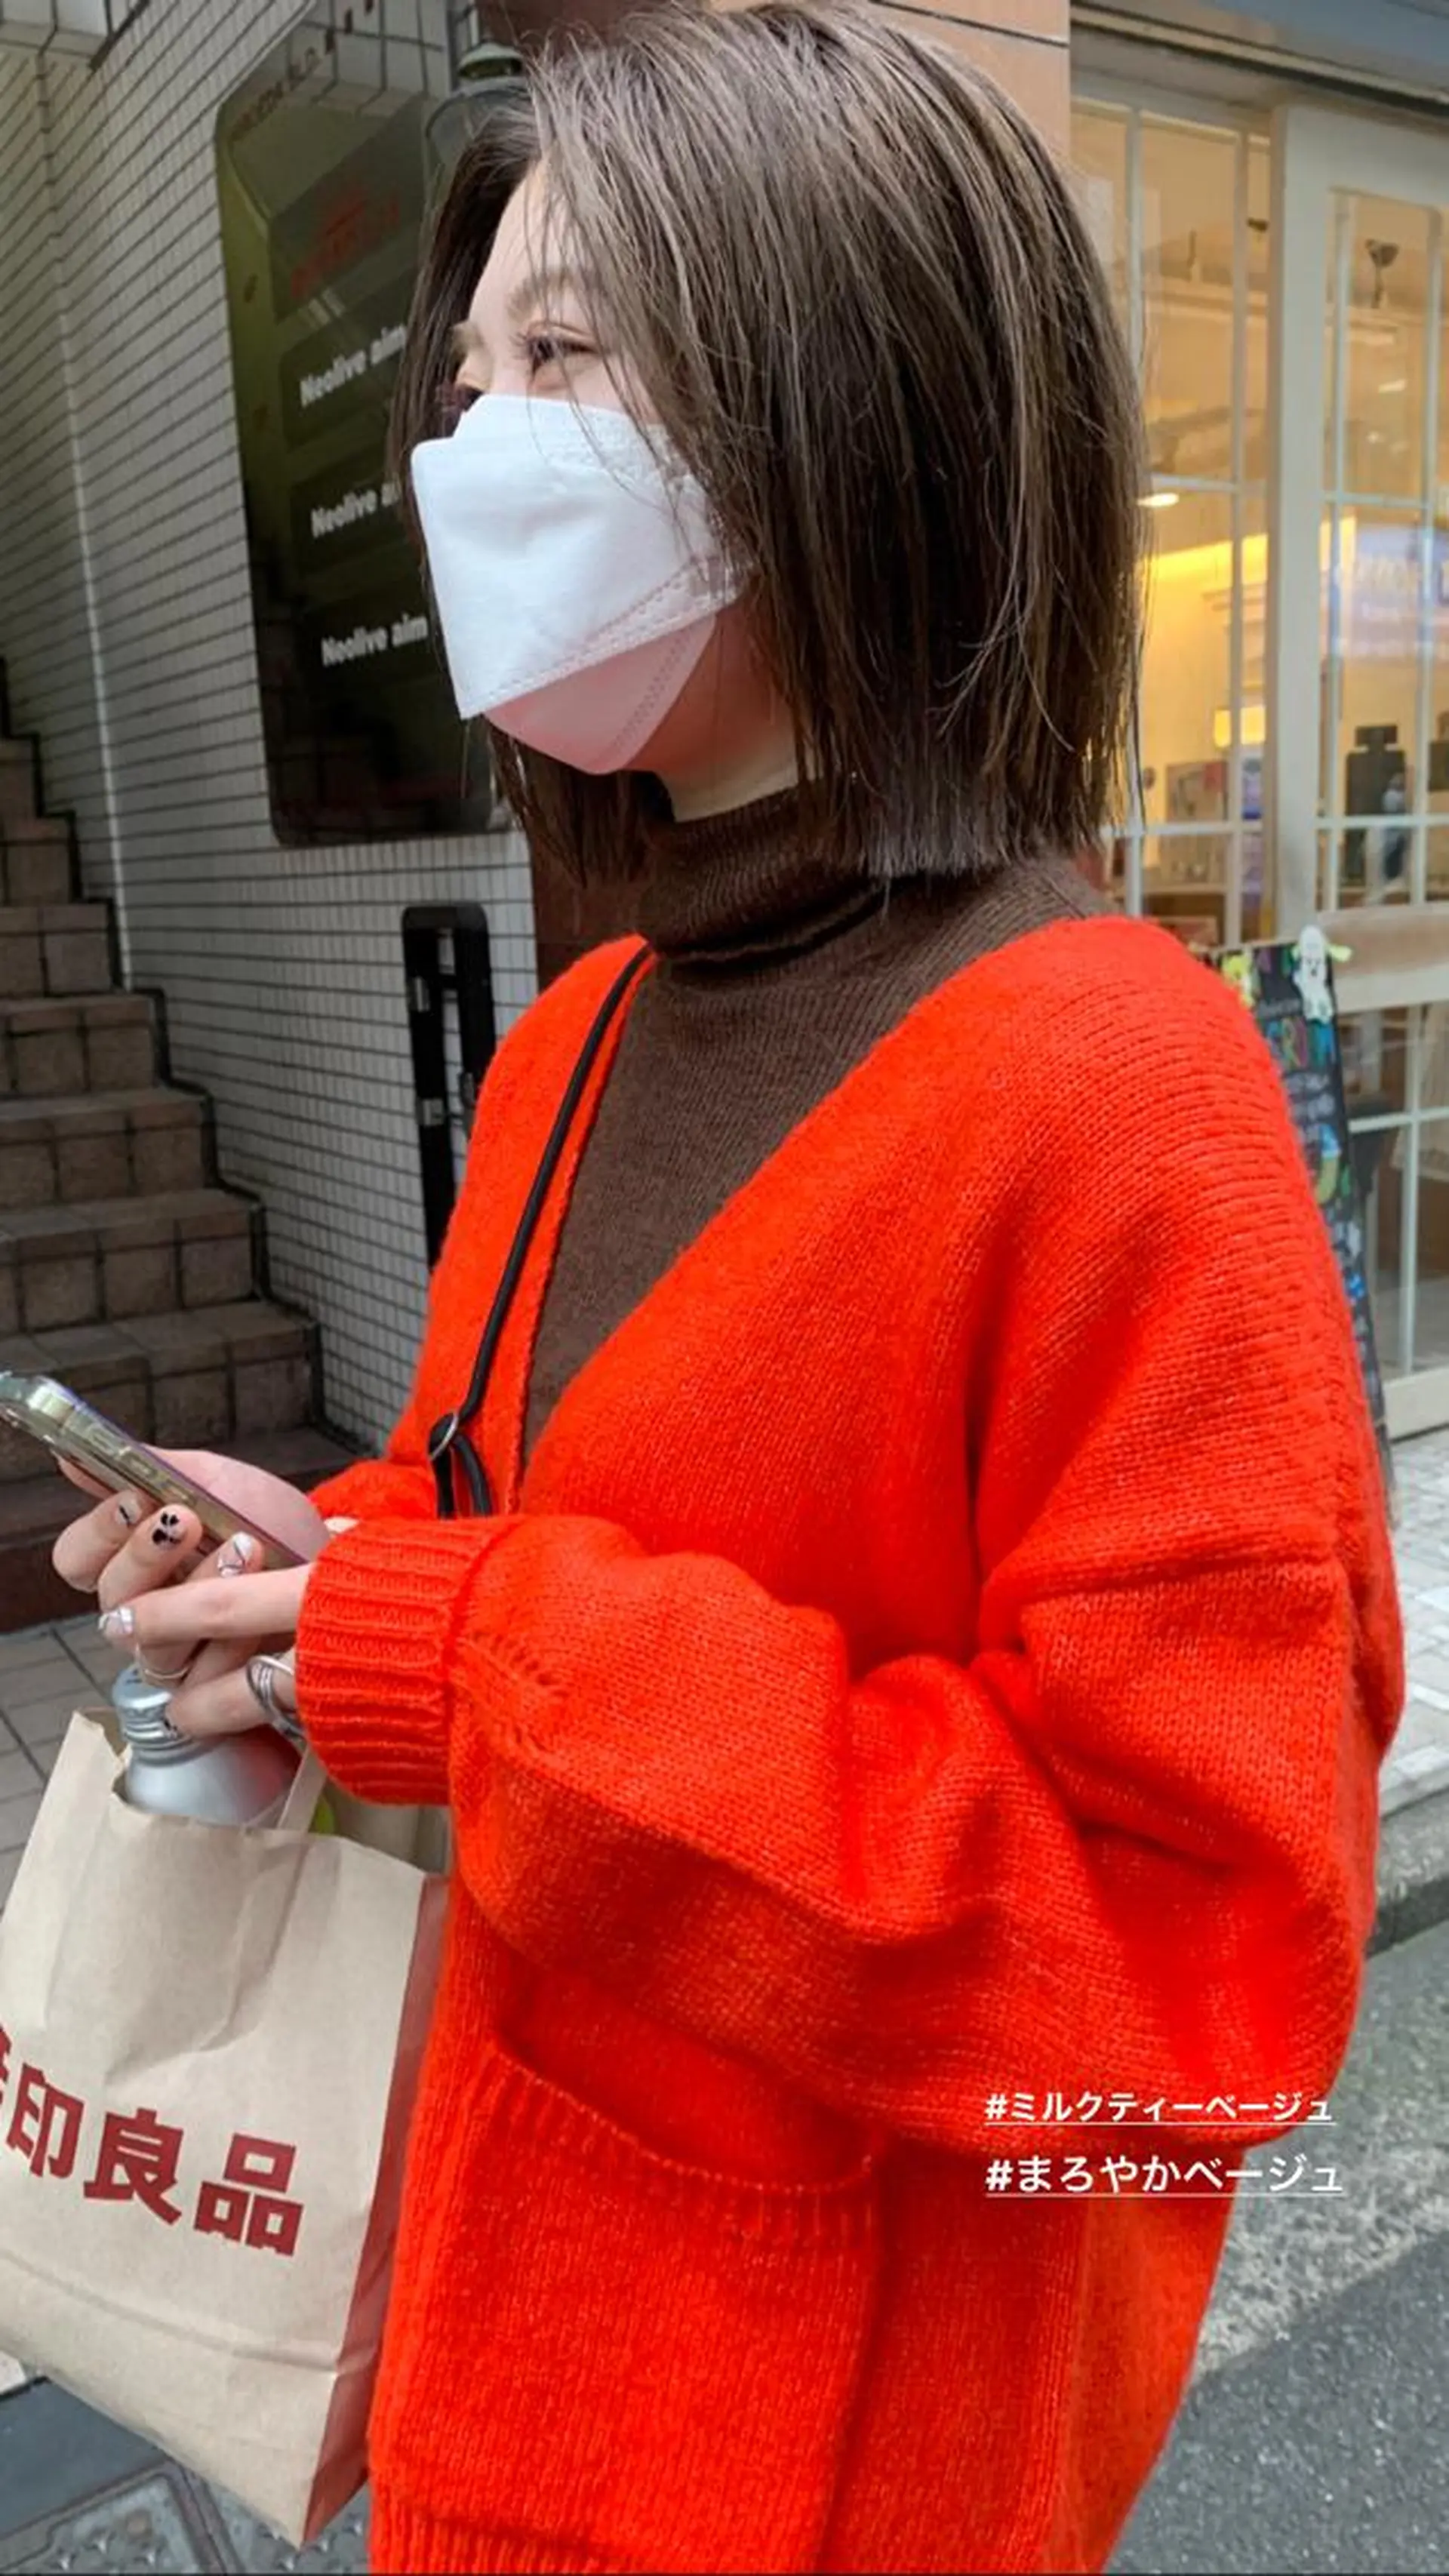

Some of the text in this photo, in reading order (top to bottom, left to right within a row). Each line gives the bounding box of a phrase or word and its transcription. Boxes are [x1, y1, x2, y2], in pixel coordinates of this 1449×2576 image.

[300, 350, 366, 408] Neolive
[312, 490, 377, 538] Neolive
[321, 613, 428, 667] Neolive aim
[0, 2023, 304, 2257] 印良品
